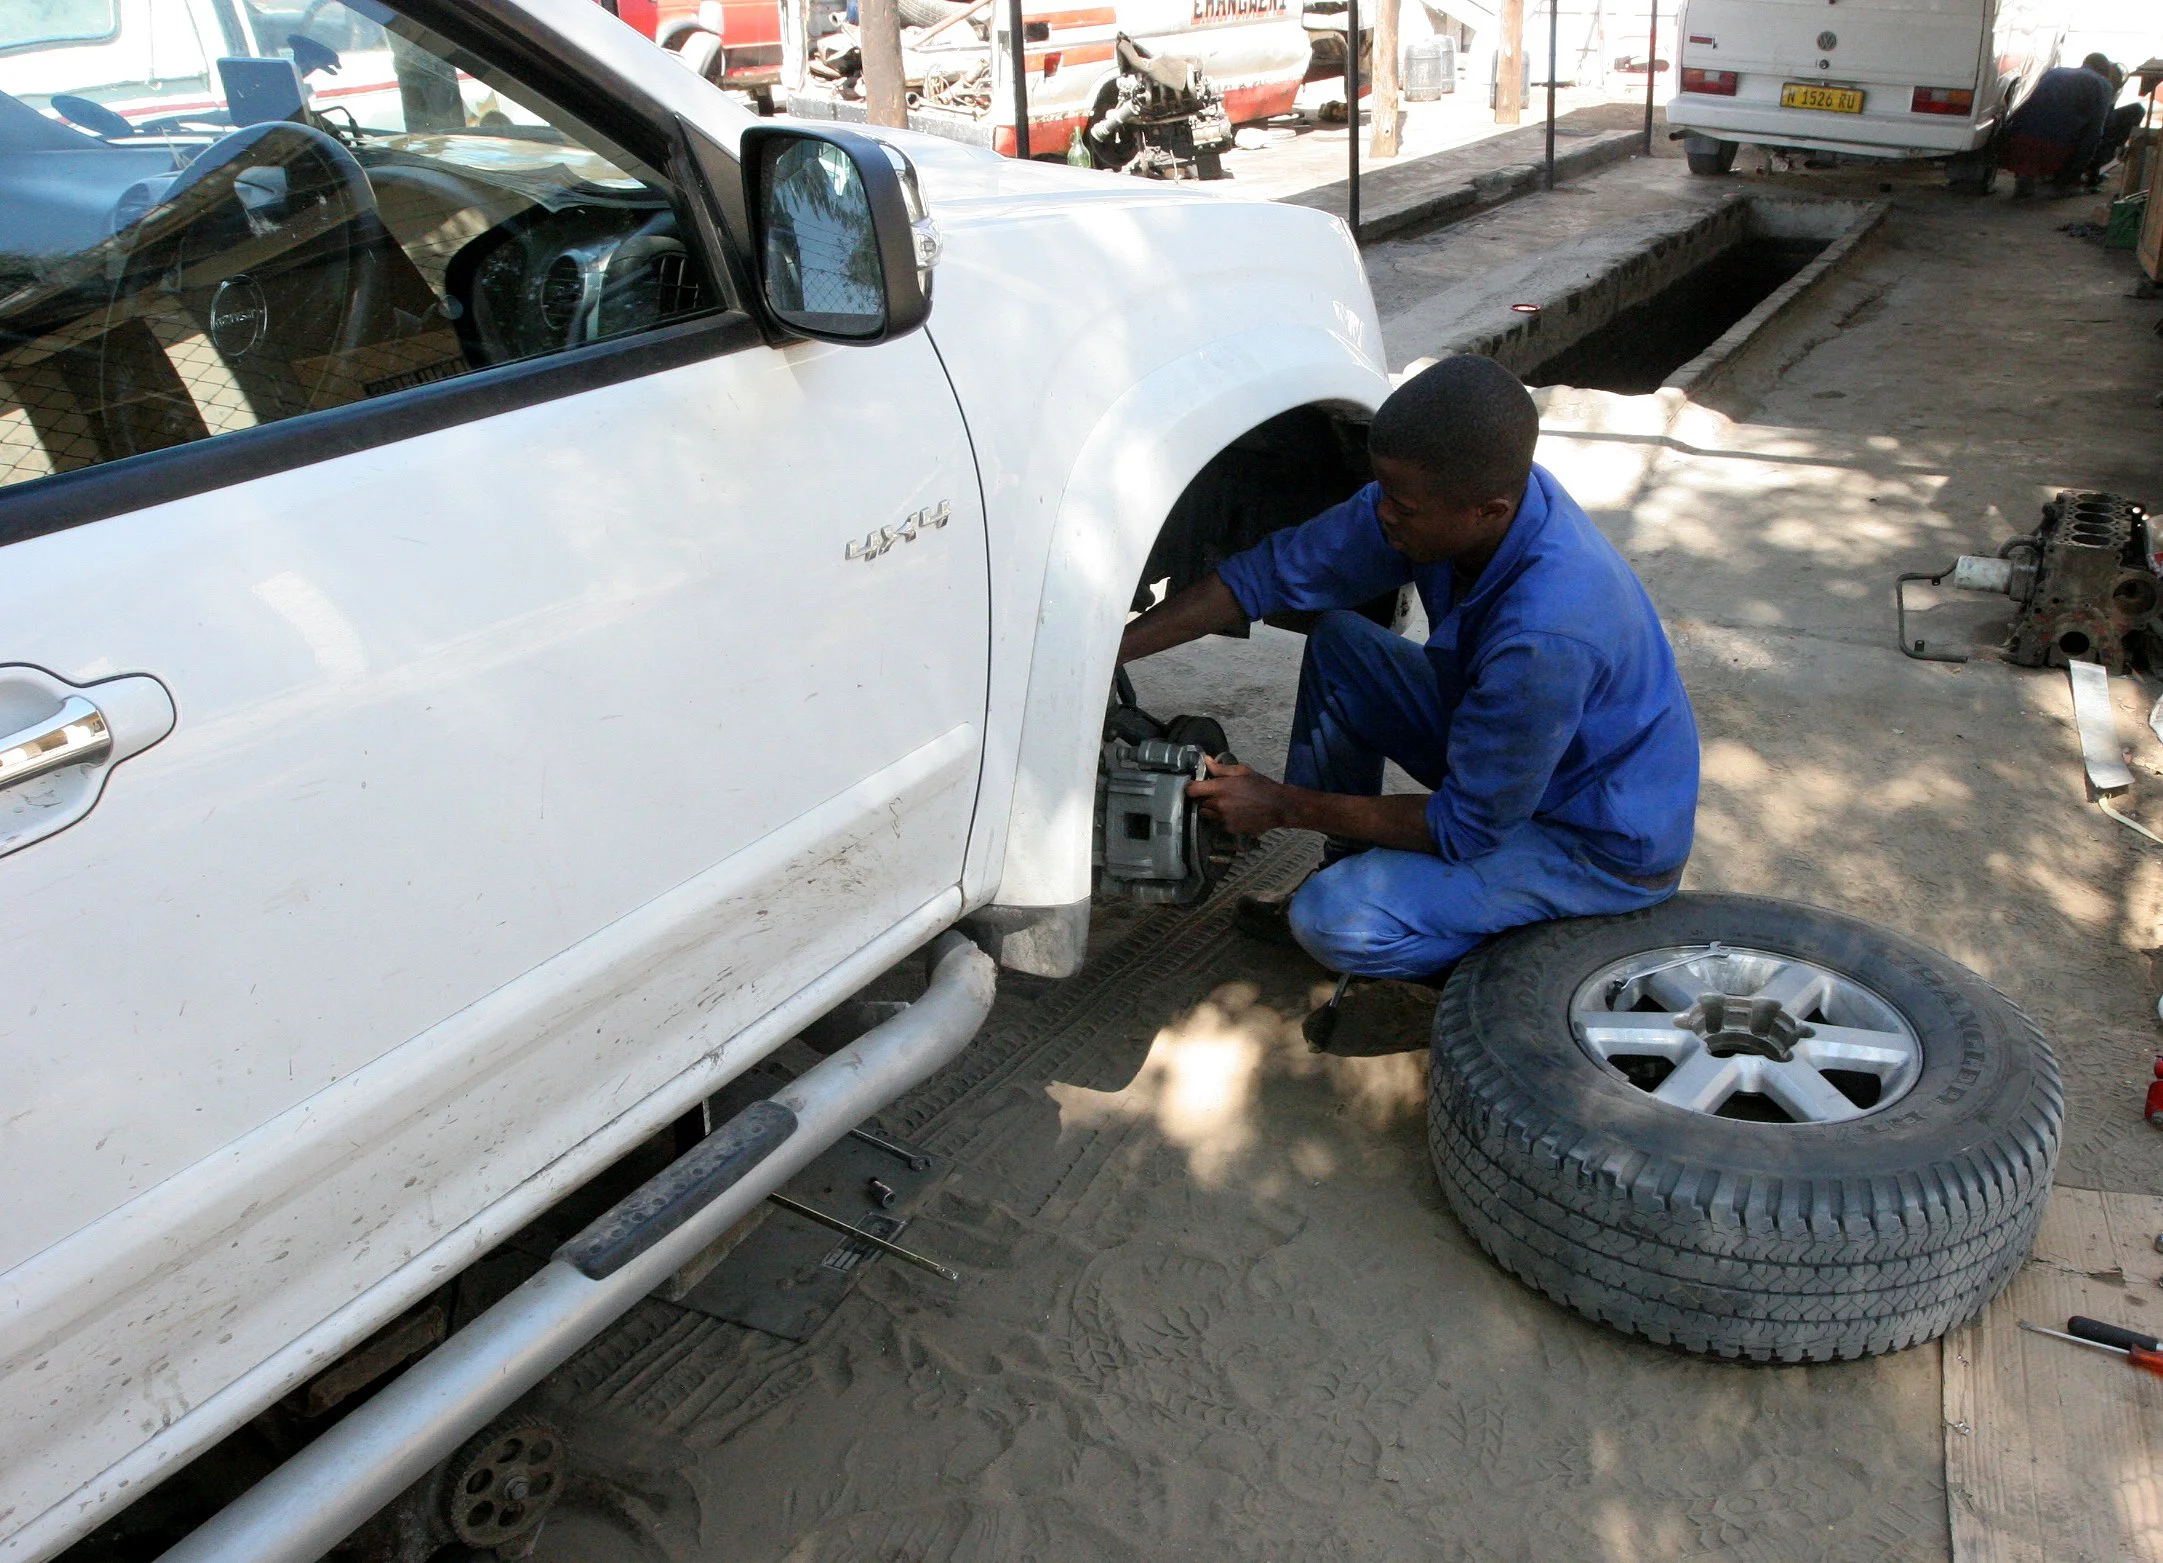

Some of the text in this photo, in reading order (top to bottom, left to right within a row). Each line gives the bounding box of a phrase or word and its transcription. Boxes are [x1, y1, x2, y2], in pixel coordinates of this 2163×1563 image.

[1787, 89, 1855, 109] N 1526 RU
